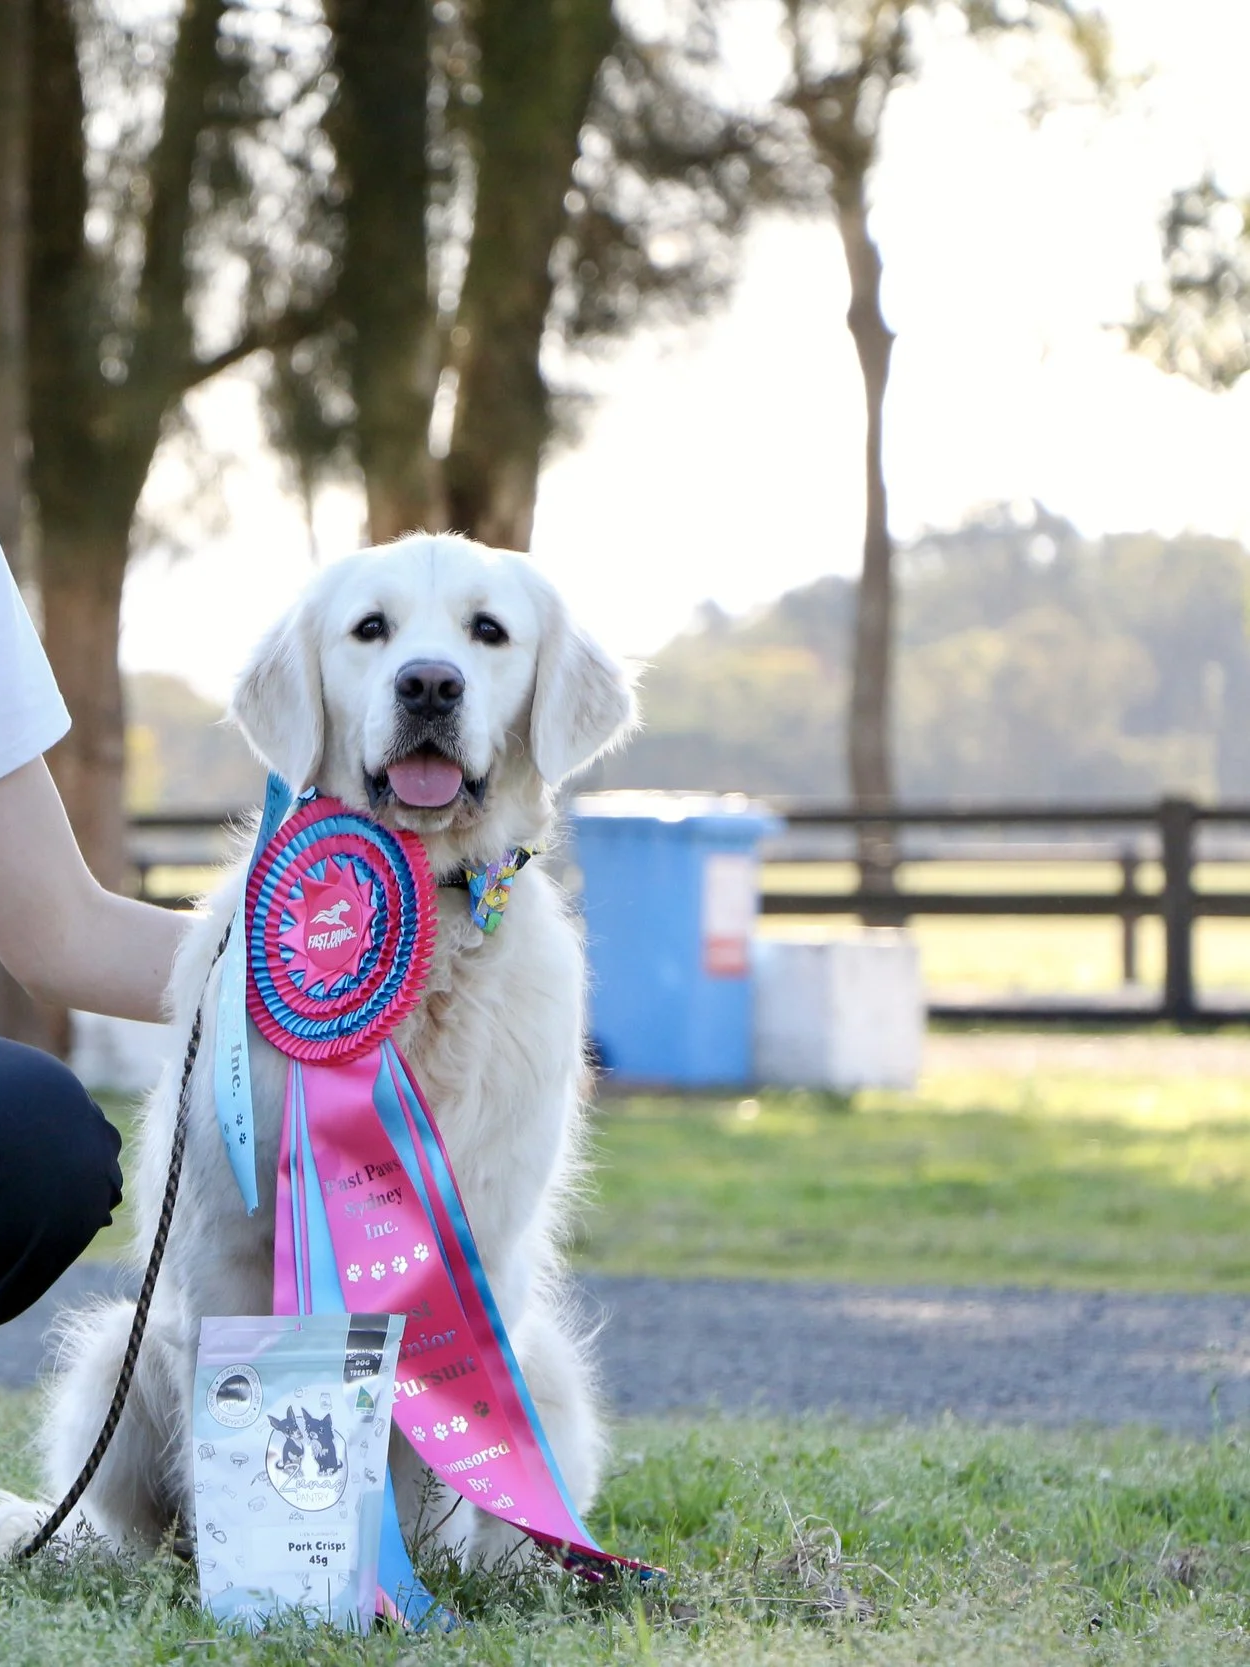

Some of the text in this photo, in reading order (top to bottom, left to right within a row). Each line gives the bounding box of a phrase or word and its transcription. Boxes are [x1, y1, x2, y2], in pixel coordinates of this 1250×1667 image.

[307, 932, 330, 949] FAST
[230, 1041, 243, 1098] Inc.
[363, 1159, 402, 1182] Paws
[344, 1187, 403, 1219] Sydney
[364, 1220, 399, 1241] Inc.
[350, 1369, 374, 1377] TREATS
[467, 1477, 493, 1494] By:
[288, 1541, 346, 1553] Pork Crisps
[309, 1555, 328, 1567] 45g
